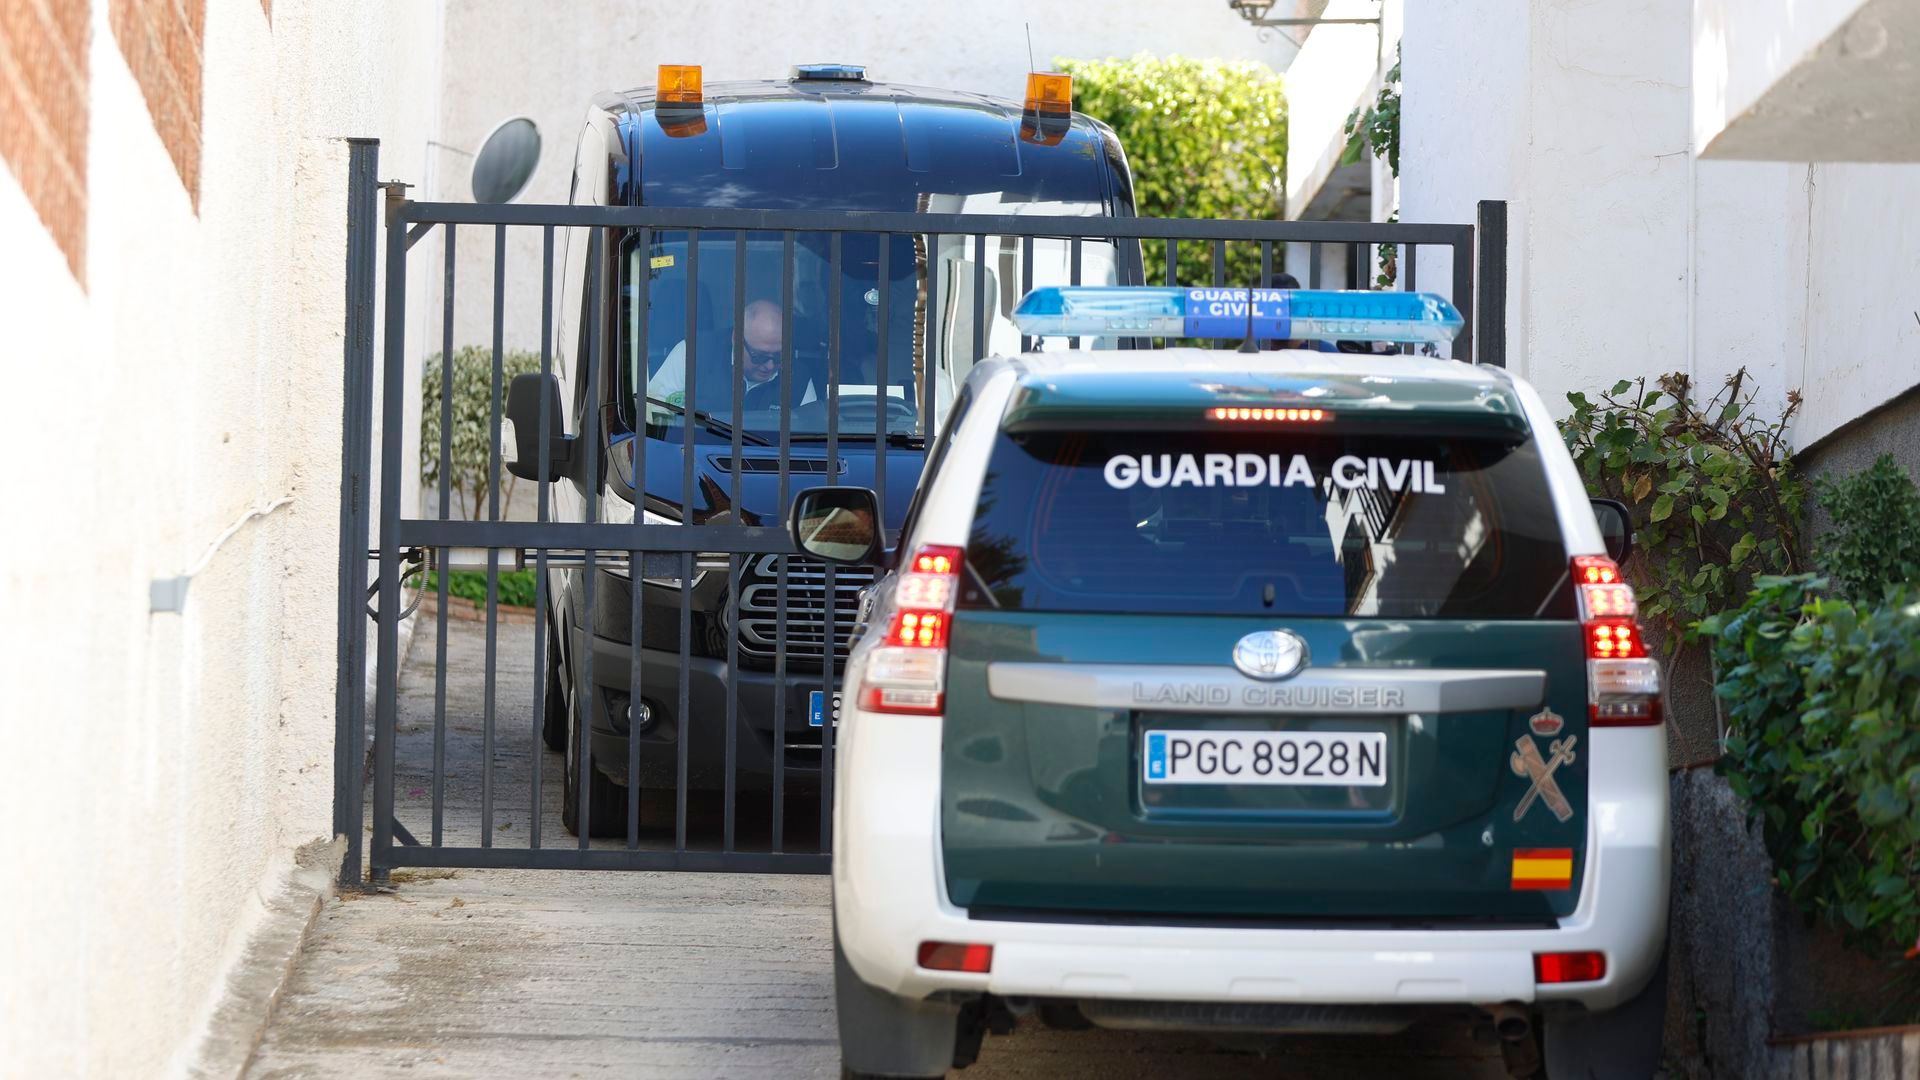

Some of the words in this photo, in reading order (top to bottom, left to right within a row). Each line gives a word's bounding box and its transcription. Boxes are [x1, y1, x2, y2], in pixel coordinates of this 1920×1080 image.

[1190, 290, 1282, 302] GUARDIA
[1209, 302, 1264, 317] CIVIL
[1103, 454, 1316, 489] GUARDIA
[1331, 455, 1446, 495] CIVIL
[1132, 682, 1231, 705] LAND
[1241, 685, 1405, 708] CRUISER
